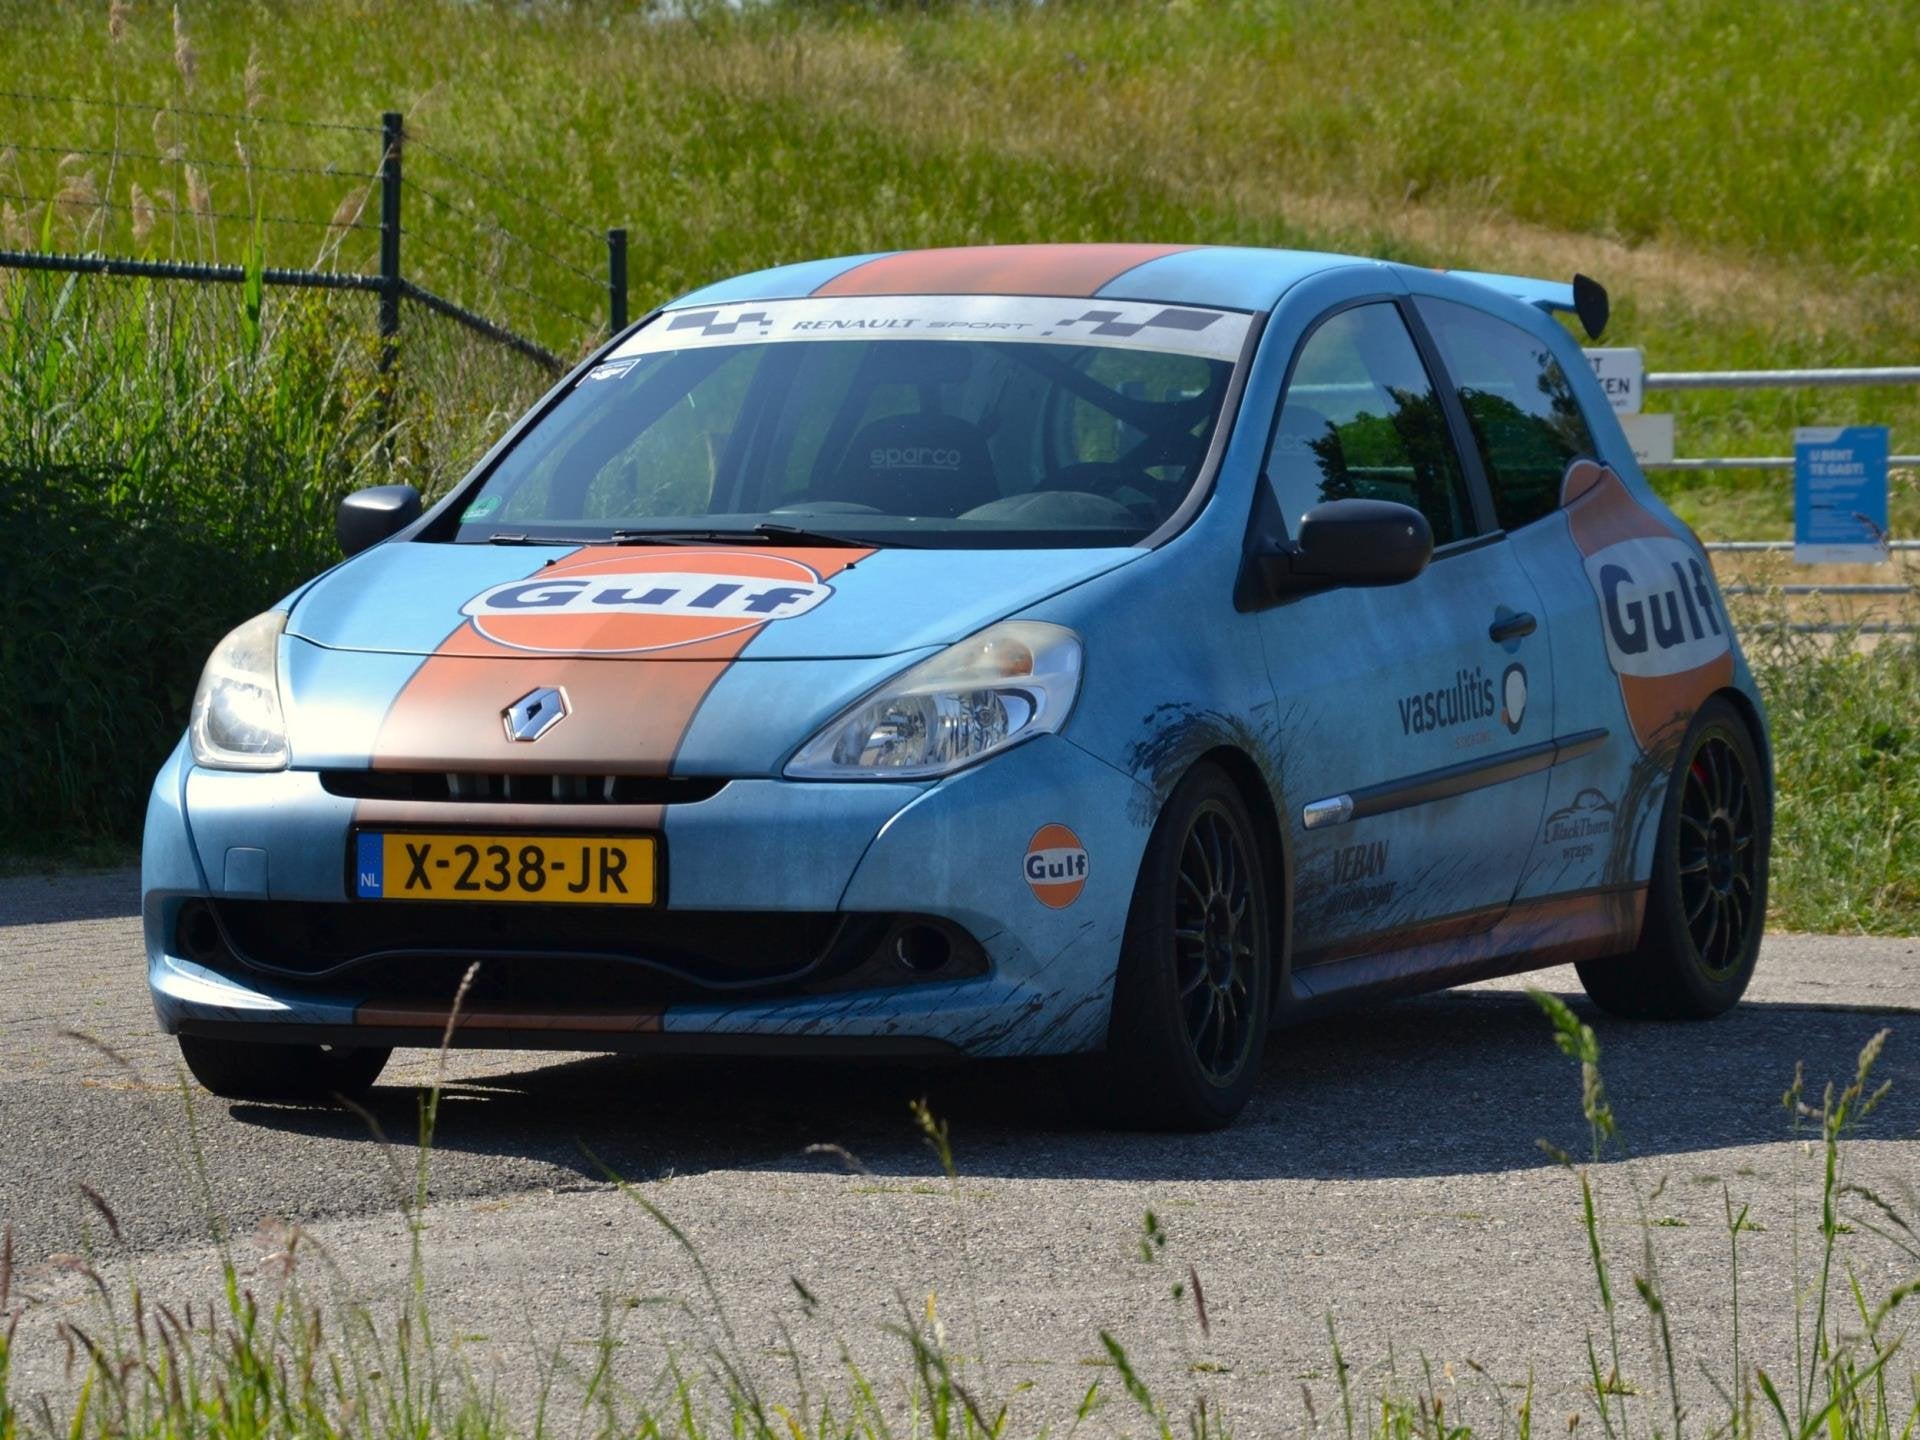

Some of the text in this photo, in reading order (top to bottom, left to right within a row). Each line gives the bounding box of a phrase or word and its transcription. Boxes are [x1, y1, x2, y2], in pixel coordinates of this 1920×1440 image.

[792, 318, 1033, 330] RENAULT SPORT
[870, 447, 961, 470] sparco
[484, 579, 815, 614] Gulf
[1600, 558, 1721, 655] Gulf
[1398, 665, 1496, 736] vasculitis
[361, 873, 380, 888] NL
[405, 842, 629, 895] X-238-JR
[1026, 855, 1086, 879] Gulf
